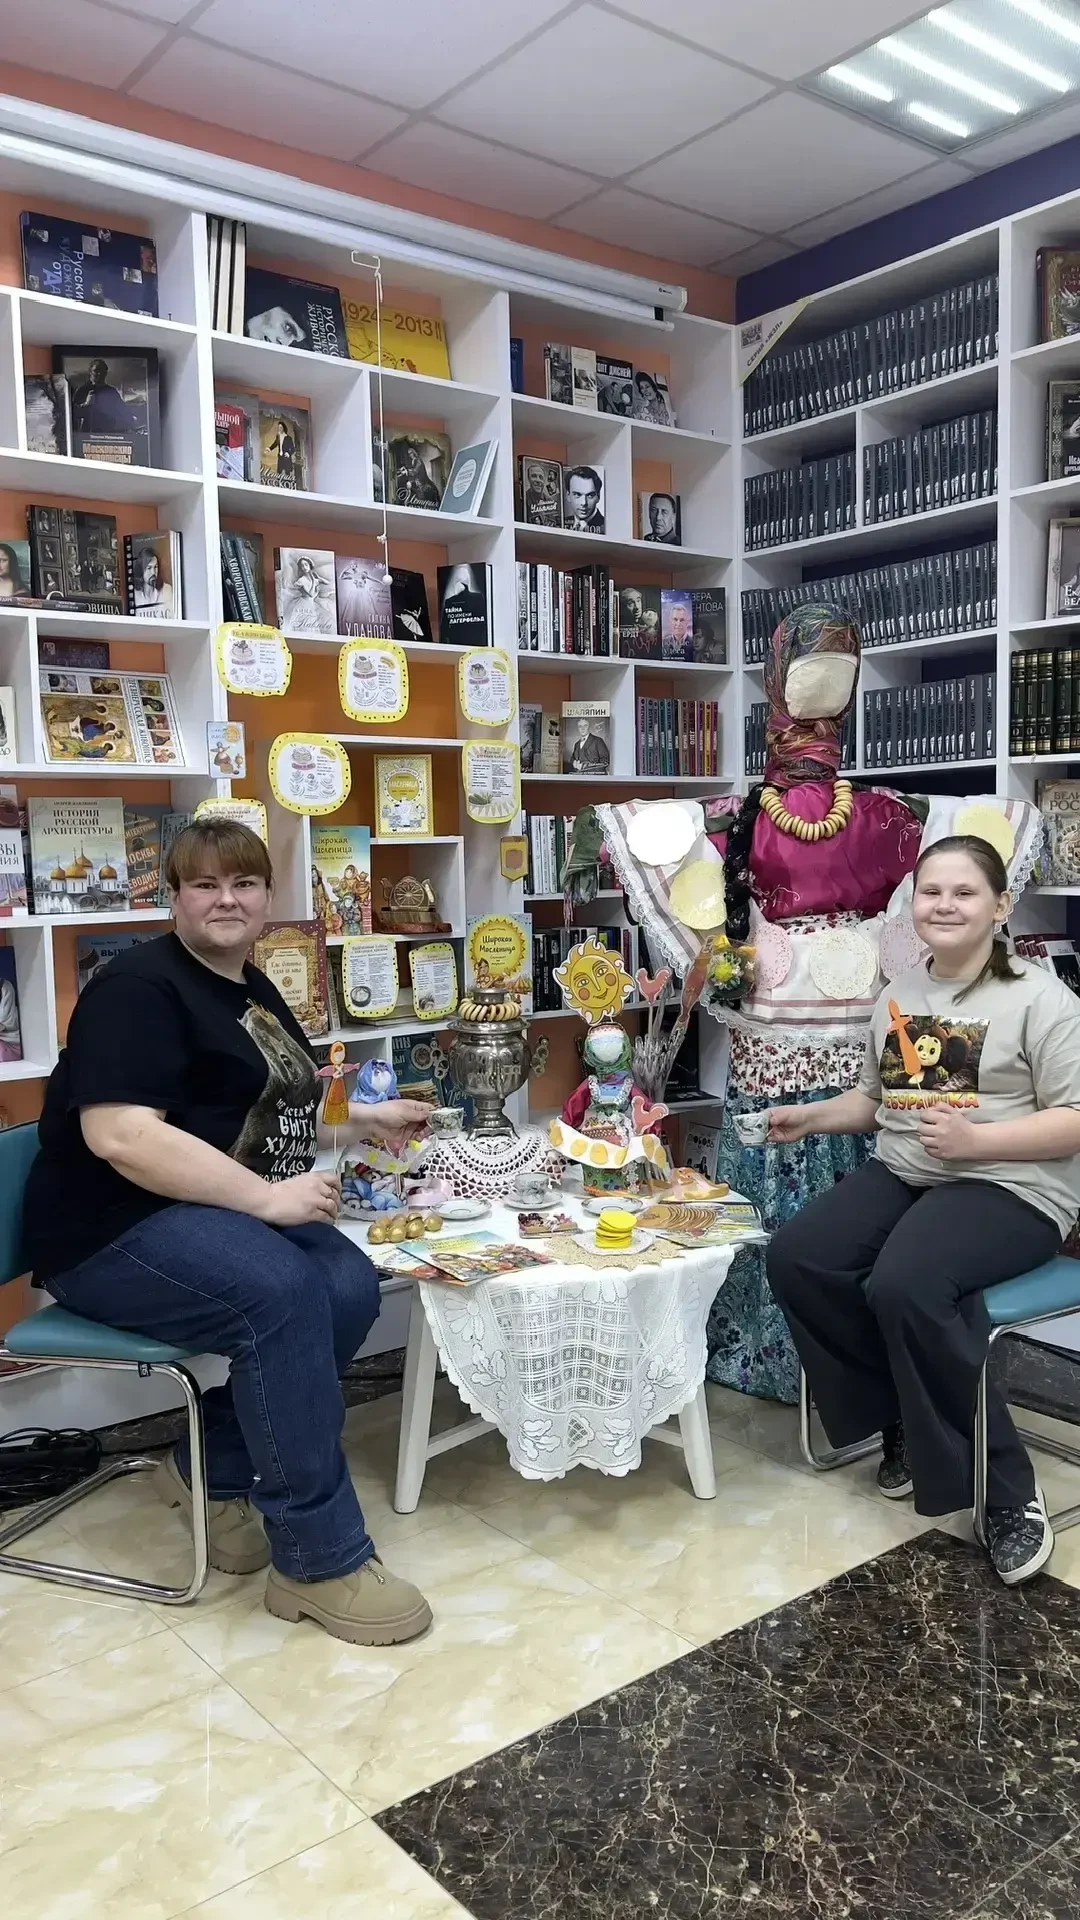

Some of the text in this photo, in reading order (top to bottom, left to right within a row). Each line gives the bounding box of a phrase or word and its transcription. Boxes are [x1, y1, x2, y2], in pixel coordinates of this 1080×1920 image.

[746, 342, 765, 367] СЕРИЯ
[444, 606, 463, 614] ТАЙНА
[345, 622, 393, 640] УЛАНОВА
[567, 708, 606, 716] ШАЛЯПИН
[1049, 800, 1080, 811] РОС
[53, 809, 100, 818] ИСТОРИЯ
[54, 817, 100, 827] РУССКОЙ
[41, 826, 113, 836] АРХИТЕКТУРЫ
[482, 934, 513, 946] Широкая
[479, 944, 516, 955] Масленица
[275, 1097, 287, 1110] НЕ
[277, 1114, 316, 1140] БЫТЬ
[270, 1158, 306, 1176] НАДО
